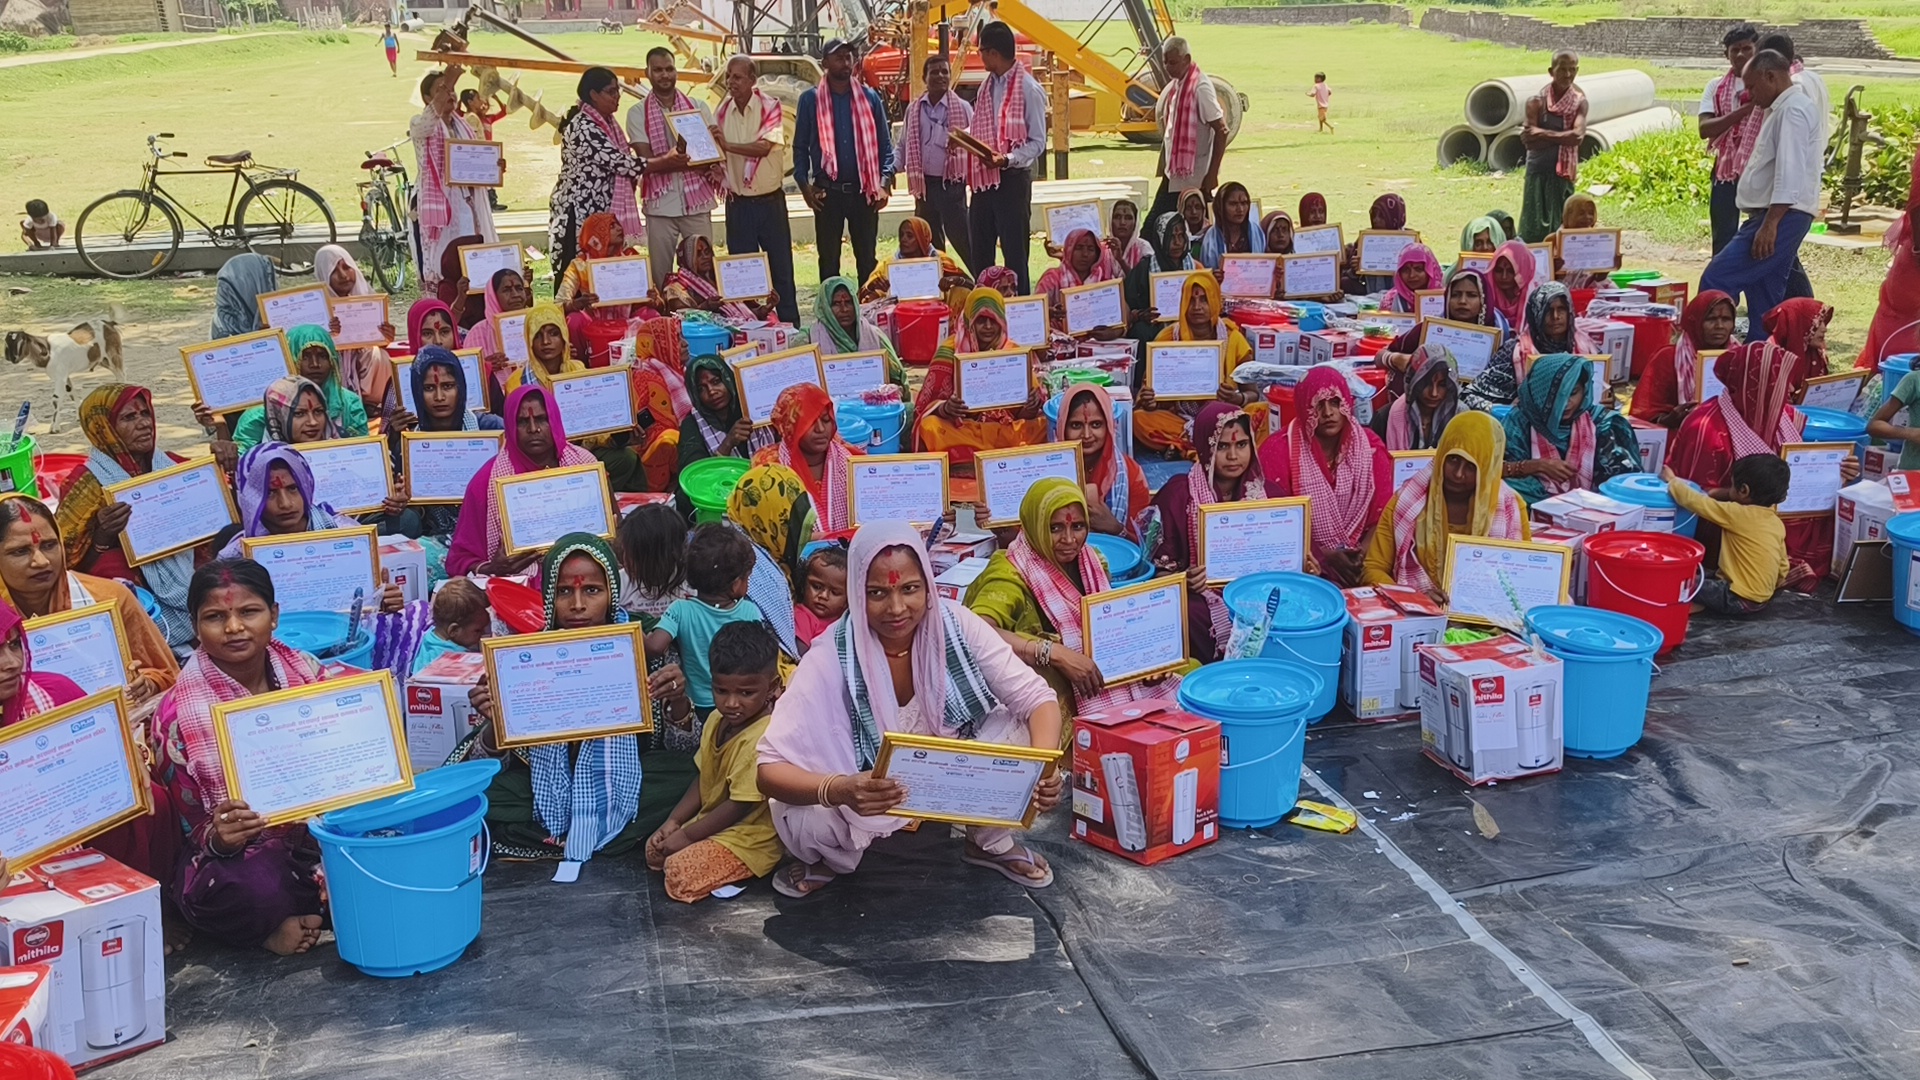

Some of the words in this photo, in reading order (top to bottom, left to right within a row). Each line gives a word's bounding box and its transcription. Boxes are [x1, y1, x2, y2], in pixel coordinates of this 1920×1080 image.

[410, 703, 440, 712] mithila
[1153, 741, 1170, 798] FILTER
[18, 944, 60, 964] mithila
